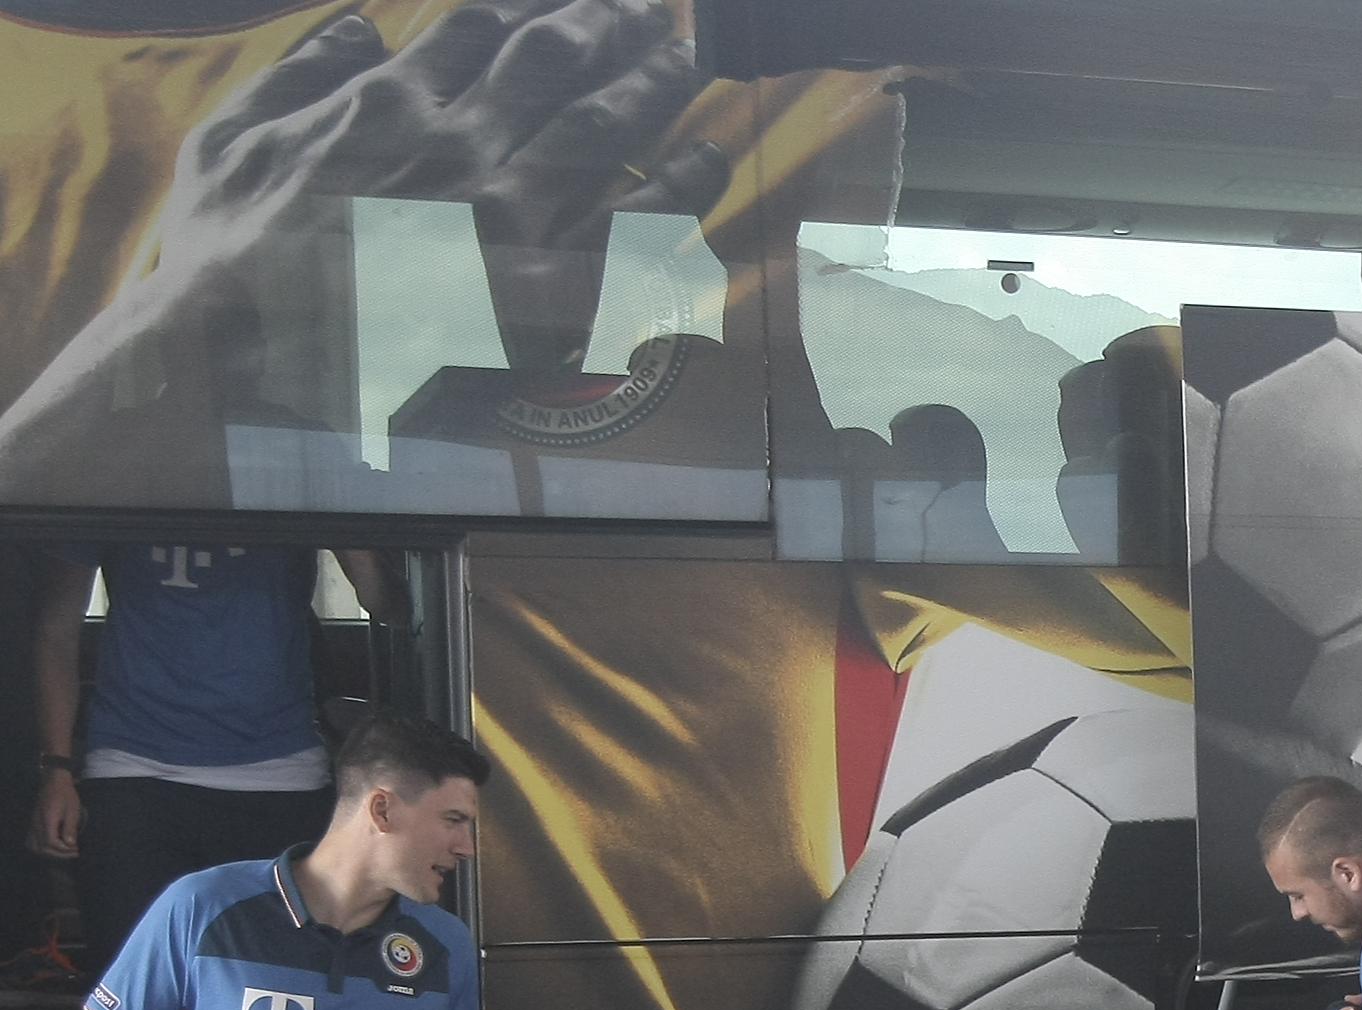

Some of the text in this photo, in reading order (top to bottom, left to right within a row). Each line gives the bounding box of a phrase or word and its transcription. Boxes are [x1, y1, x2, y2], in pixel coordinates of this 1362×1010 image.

[531, 404, 552, 428] IN
[558, 402, 620, 429] ANUL
[615, 366, 657, 409] 1909
